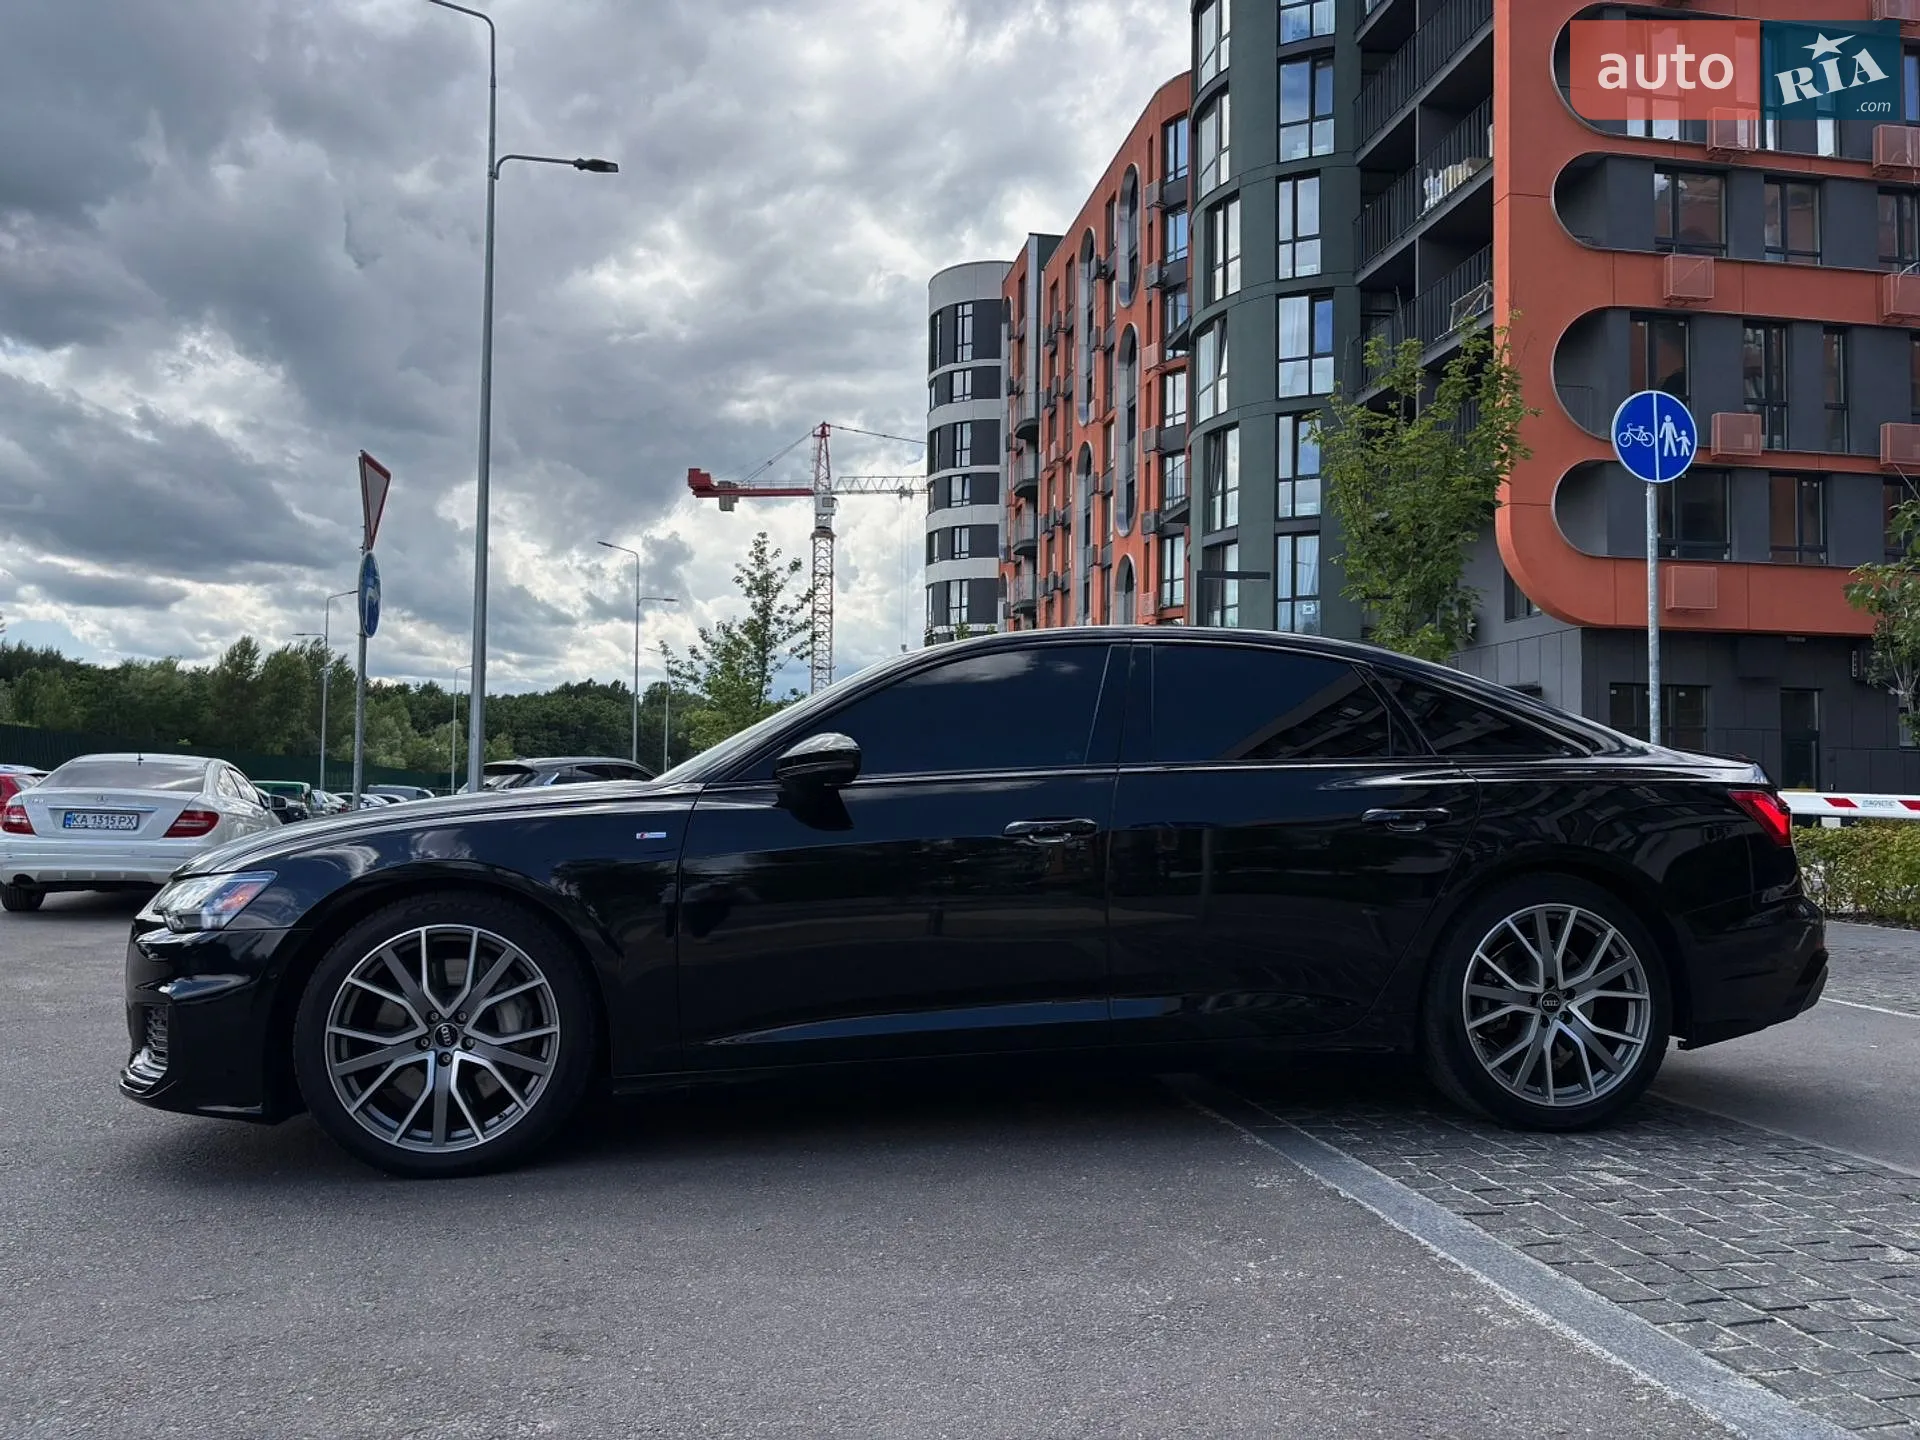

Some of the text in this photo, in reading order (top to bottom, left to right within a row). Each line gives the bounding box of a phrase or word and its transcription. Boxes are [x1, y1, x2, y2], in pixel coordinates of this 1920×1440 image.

[73, 814, 135, 826] KA 1315 PX
